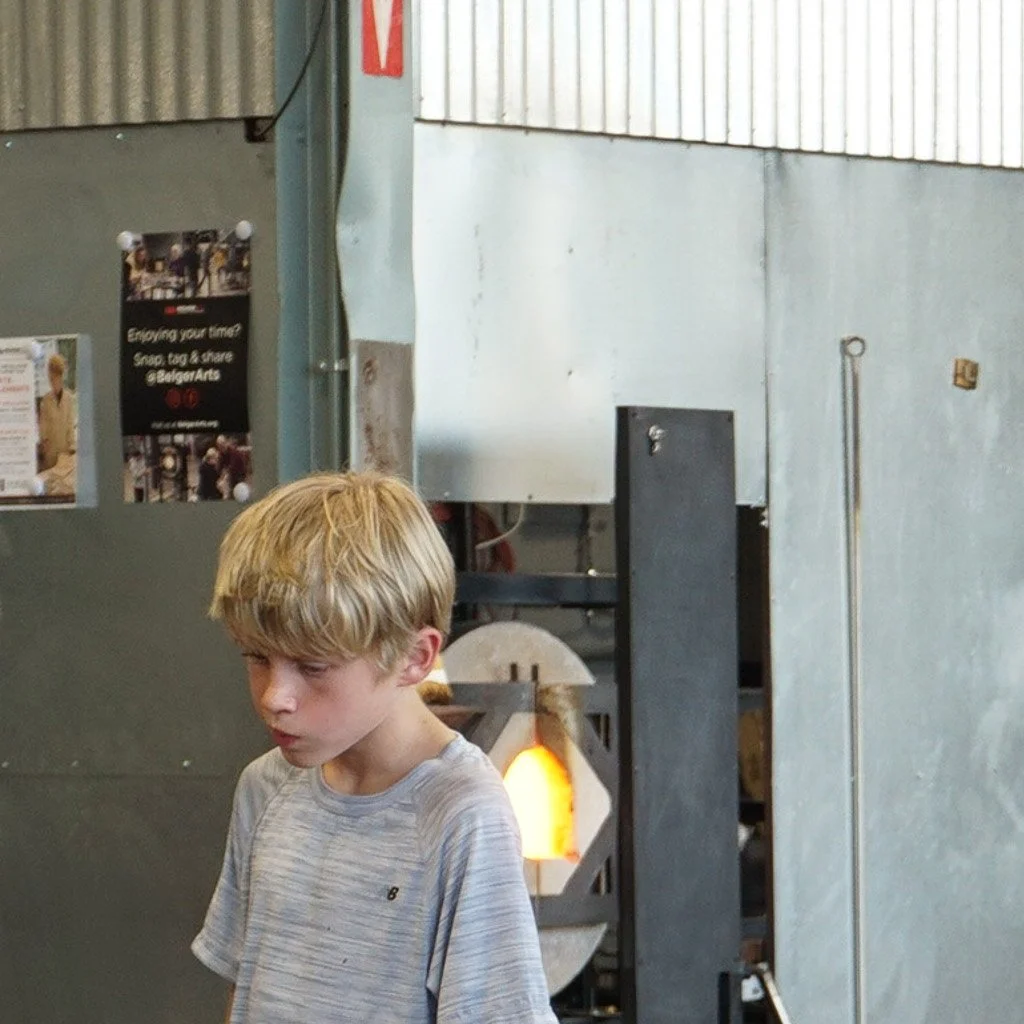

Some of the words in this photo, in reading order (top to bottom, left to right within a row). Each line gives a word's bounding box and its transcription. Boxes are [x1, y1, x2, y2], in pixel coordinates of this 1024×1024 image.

[127, 327, 177, 344] Enjoying
[179, 327, 206, 343] your
[208, 323, 242, 339] time?
[167, 351, 188, 367] tag
[189, 349, 199, 365] &
[200, 348, 234, 364] share
[145, 368, 221, 386] @BelgerArts
